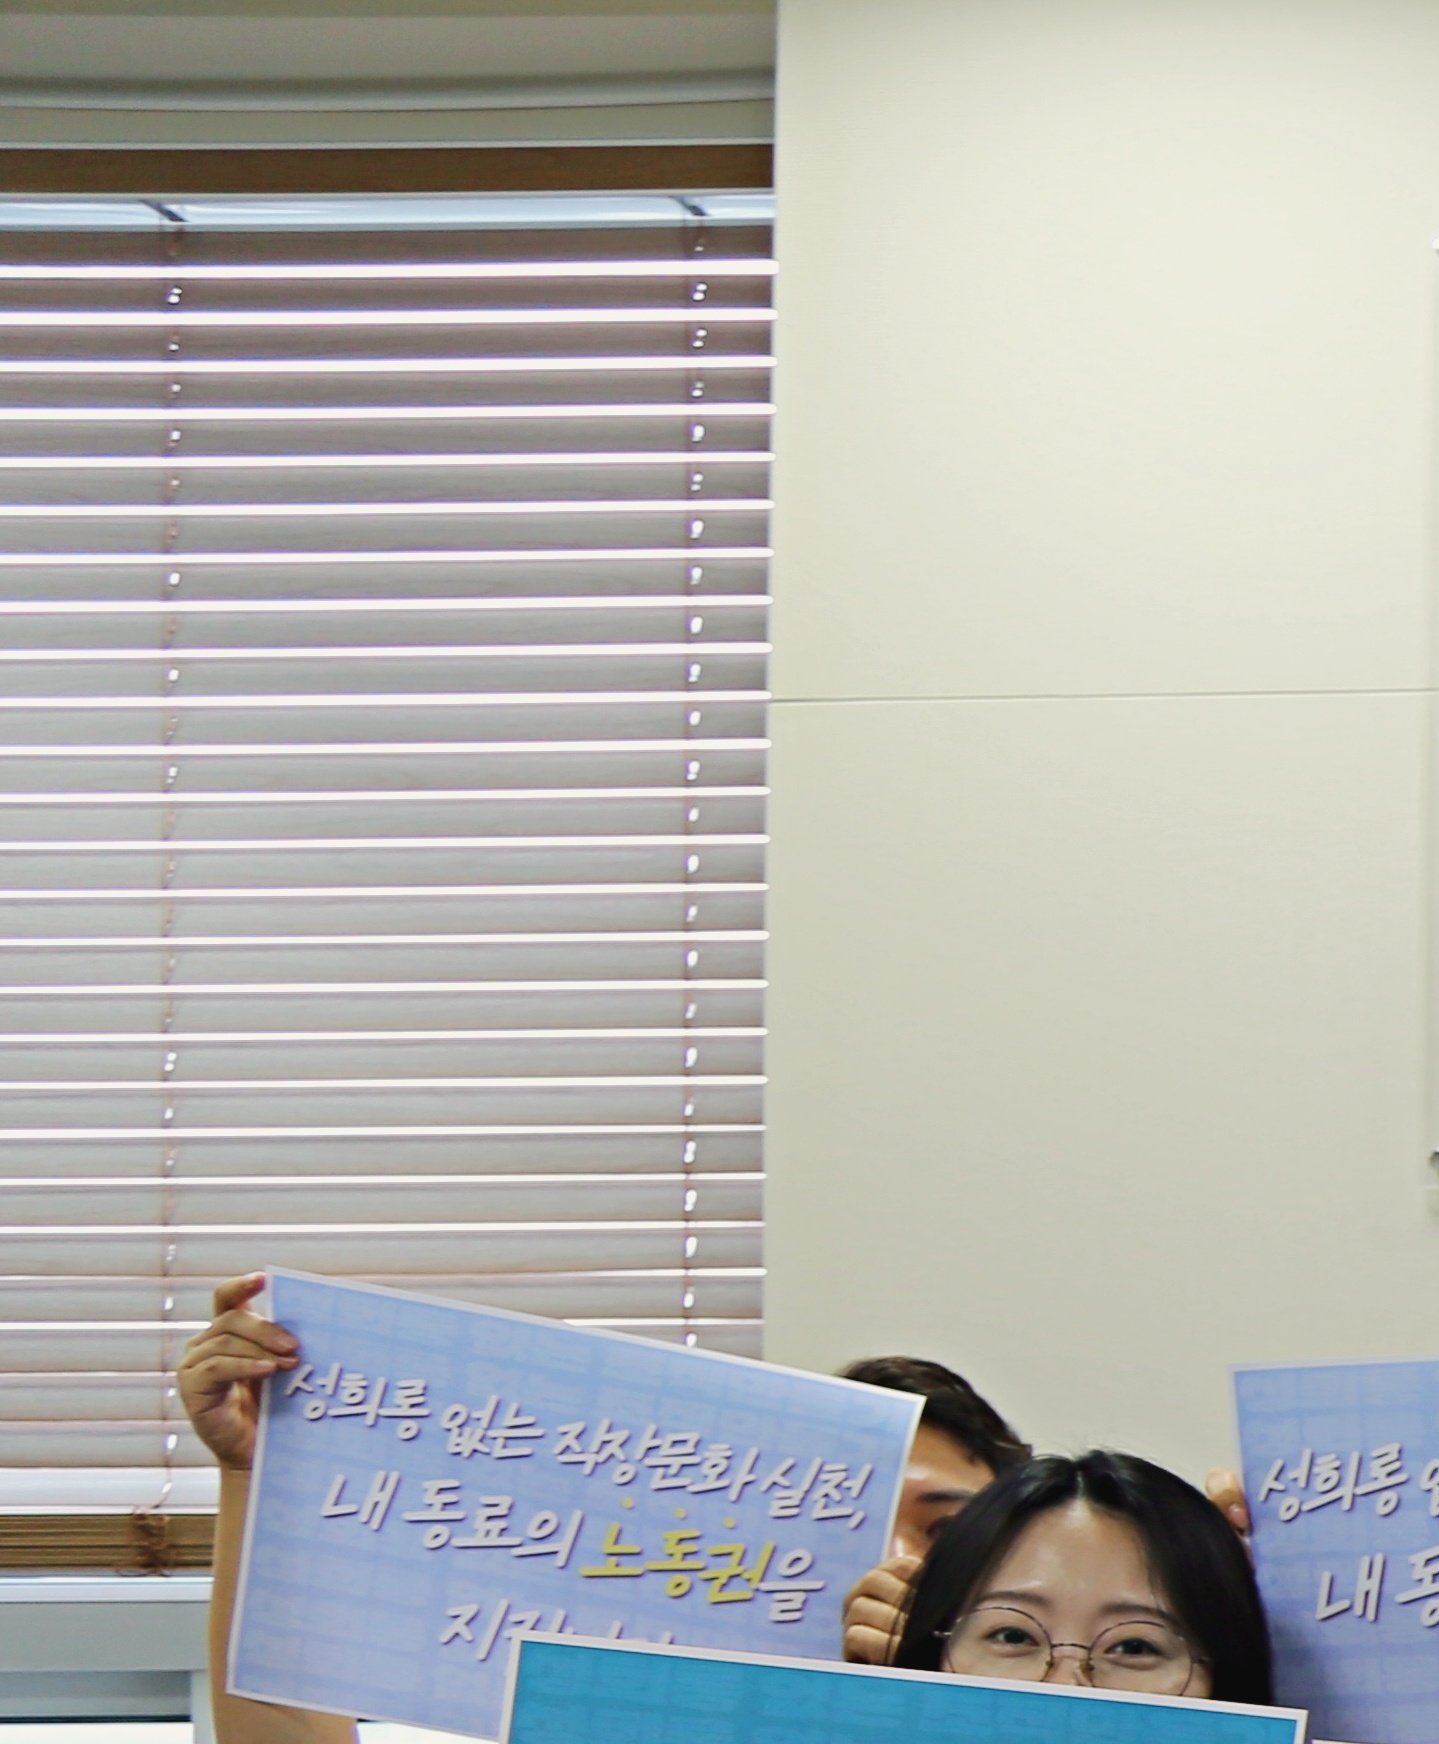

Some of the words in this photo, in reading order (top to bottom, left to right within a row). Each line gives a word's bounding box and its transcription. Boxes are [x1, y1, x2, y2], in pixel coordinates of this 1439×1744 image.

[285, 1362, 431, 1441] 성희롱
[441, 1394, 546, 1459] 없는
[552, 1417, 758, 1502] 직장문화
[759, 1456, 872, 1530] 실천,
[1259, 1443, 1409, 1522] 성희롱
[321, 1471, 400, 1530] 내
[404, 1478, 584, 1567] 동료의
[578, 1524, 825, 1623] 노동권을
[1315, 1553, 1385, 1621] 내
